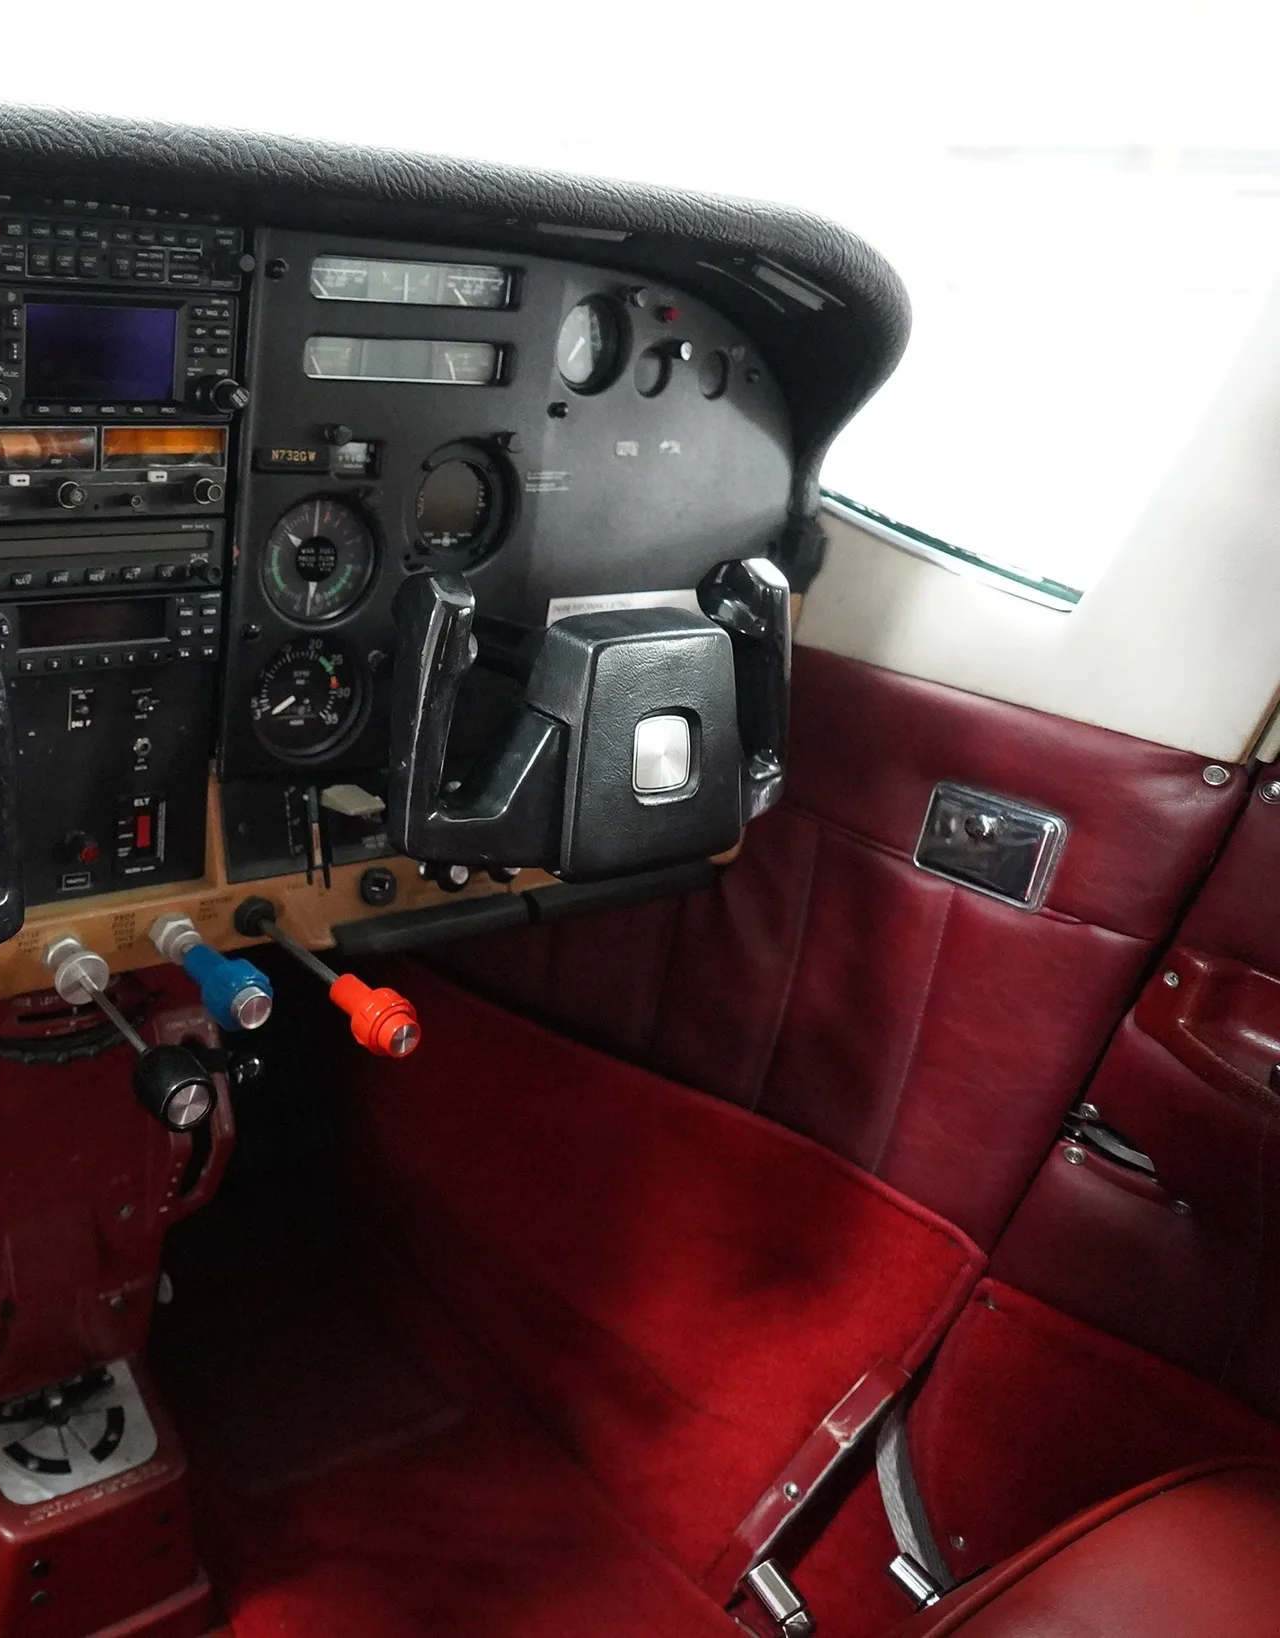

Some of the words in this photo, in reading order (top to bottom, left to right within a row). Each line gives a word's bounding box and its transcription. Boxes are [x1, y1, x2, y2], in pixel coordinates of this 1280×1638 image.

[271, 449, 317, 462] N732GW
[52, 575, 68, 584] APR
[88, 573, 106, 582] REV
[125, 571, 140, 580] ALT
[15, 577, 31, 587] NAV
